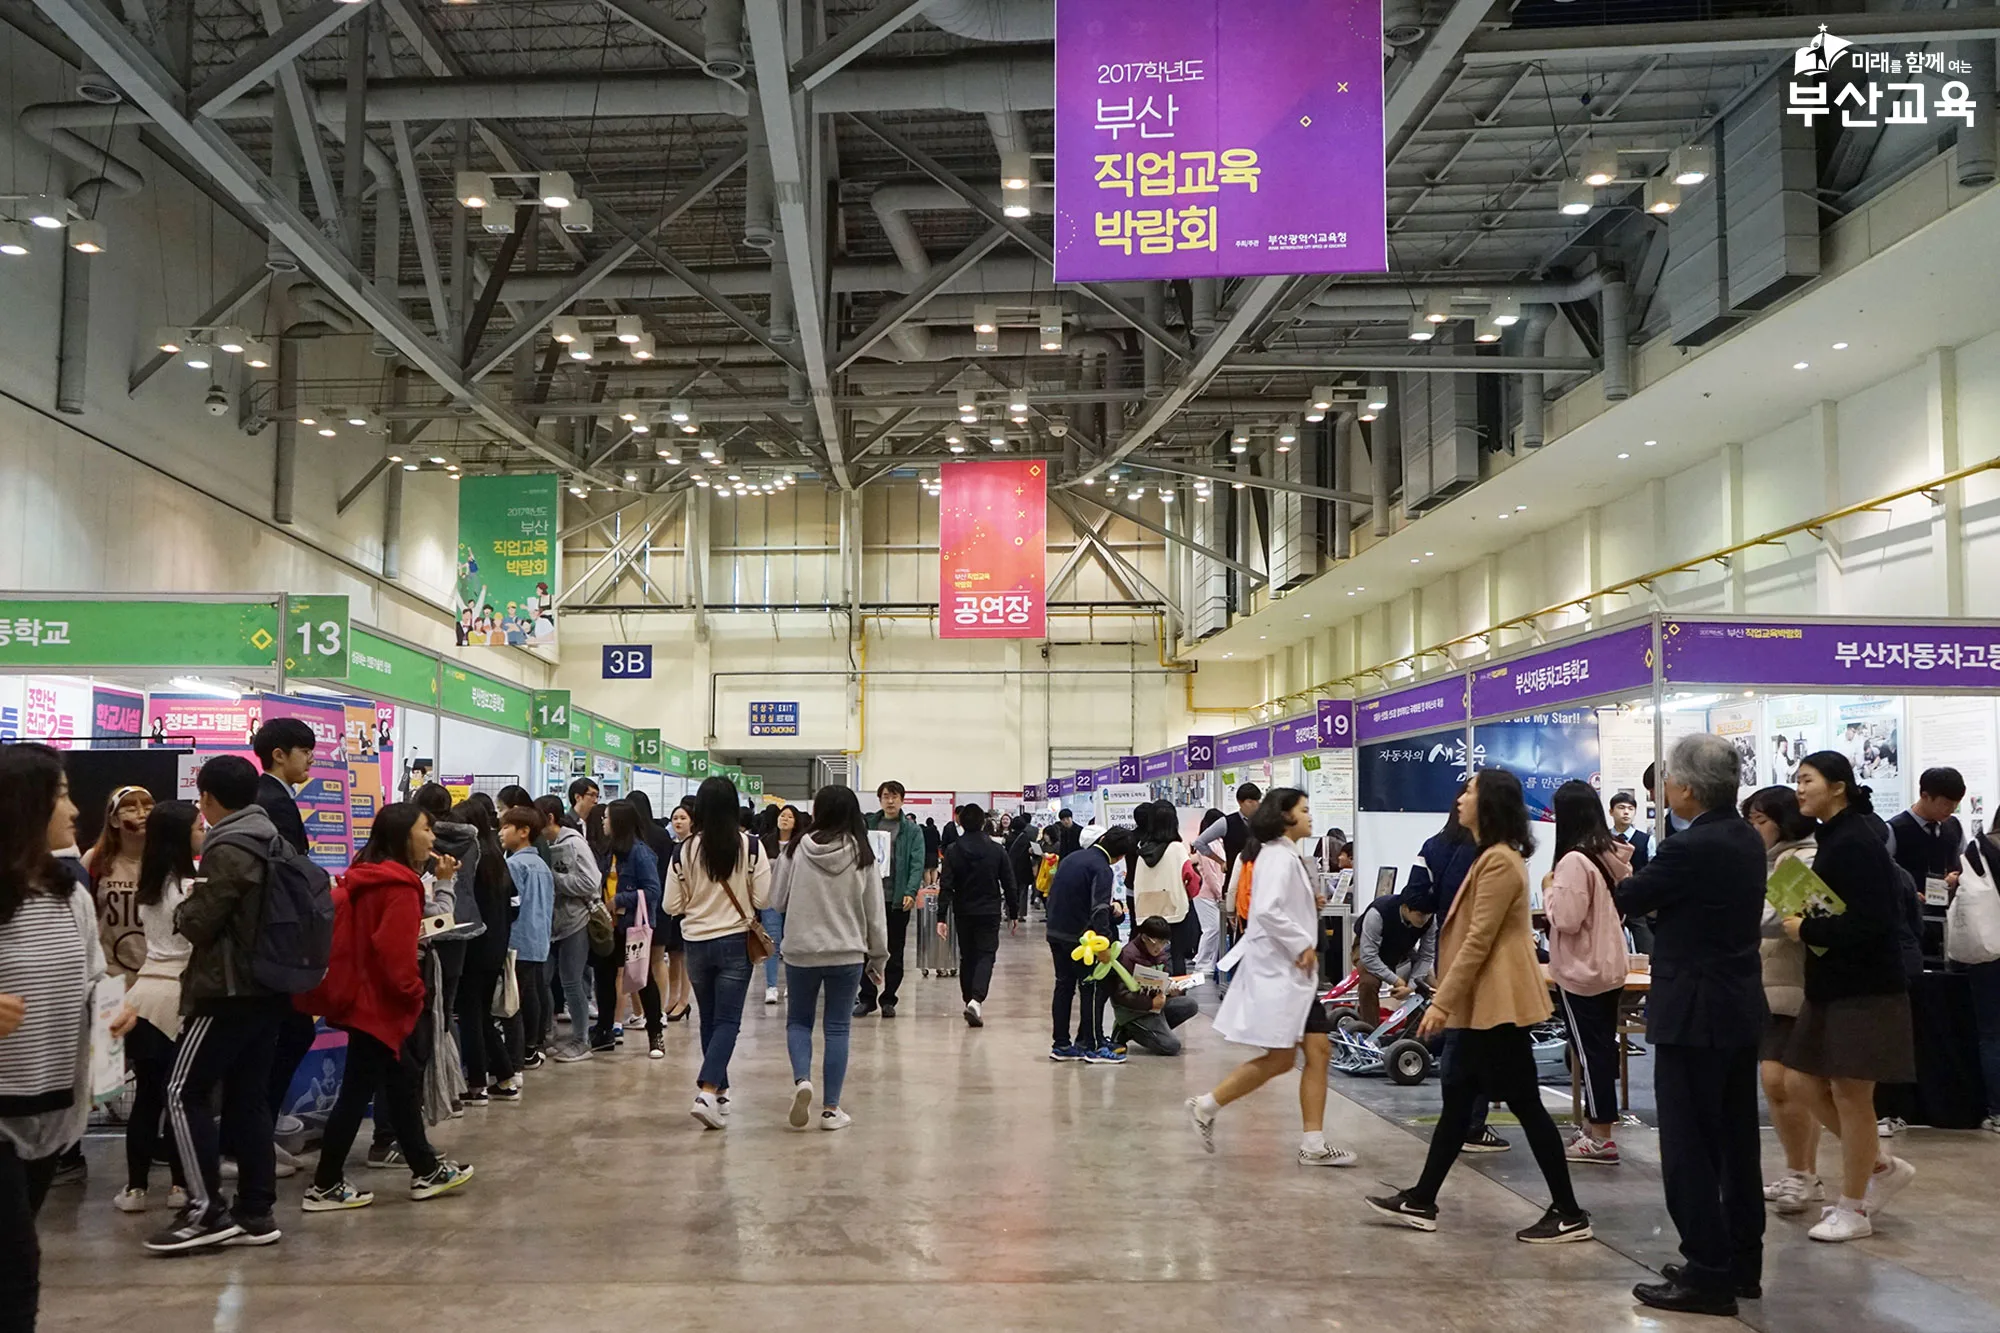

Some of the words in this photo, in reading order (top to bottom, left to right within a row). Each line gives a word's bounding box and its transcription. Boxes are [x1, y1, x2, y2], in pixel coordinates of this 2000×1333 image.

[1097, 60, 1205, 84] 2017학년도
[1094, 94, 1179, 140] 부산
[1094, 148, 1261, 198] 직업교육
[1095, 205, 1217, 256] 박람회
[1268, 232, 1347, 245] 부산광역시교육청
[521, 519, 549, 536] 부산
[493, 539, 548, 556] 직업교육
[506, 559, 547, 576] 박람회
[953, 595, 1032, 624] 공연장
[297, 621, 341, 655] 13
[610, 650, 645, 674] 3B
[1515, 659, 1589, 696] 부산자동차고등학교
[28, 688, 56, 713] 3학년
[96, 703, 140, 733] 학교시설
[248, 706, 262, 717] 01
[378, 708, 392, 719] 02
[539, 705, 566, 725] 14
[1533, 713, 1549, 726] My
[1551, 712, 1580, 724] Star!!
[165, 712, 248, 732] 정보고웹툰
[1323, 715, 1349, 735] 19
[638, 740, 658, 755] 15
[1190, 746, 1211, 761] 20
[1379, 750, 1425, 762] 자동차의
[691, 759, 707, 771] 16
[1121, 764, 1137, 777] 21
[749, 780, 760, 790] 18
[1048, 783, 1060, 794] 23
[1077, 775, 1091, 787] 22
[1024, 789, 1036, 799] 24
